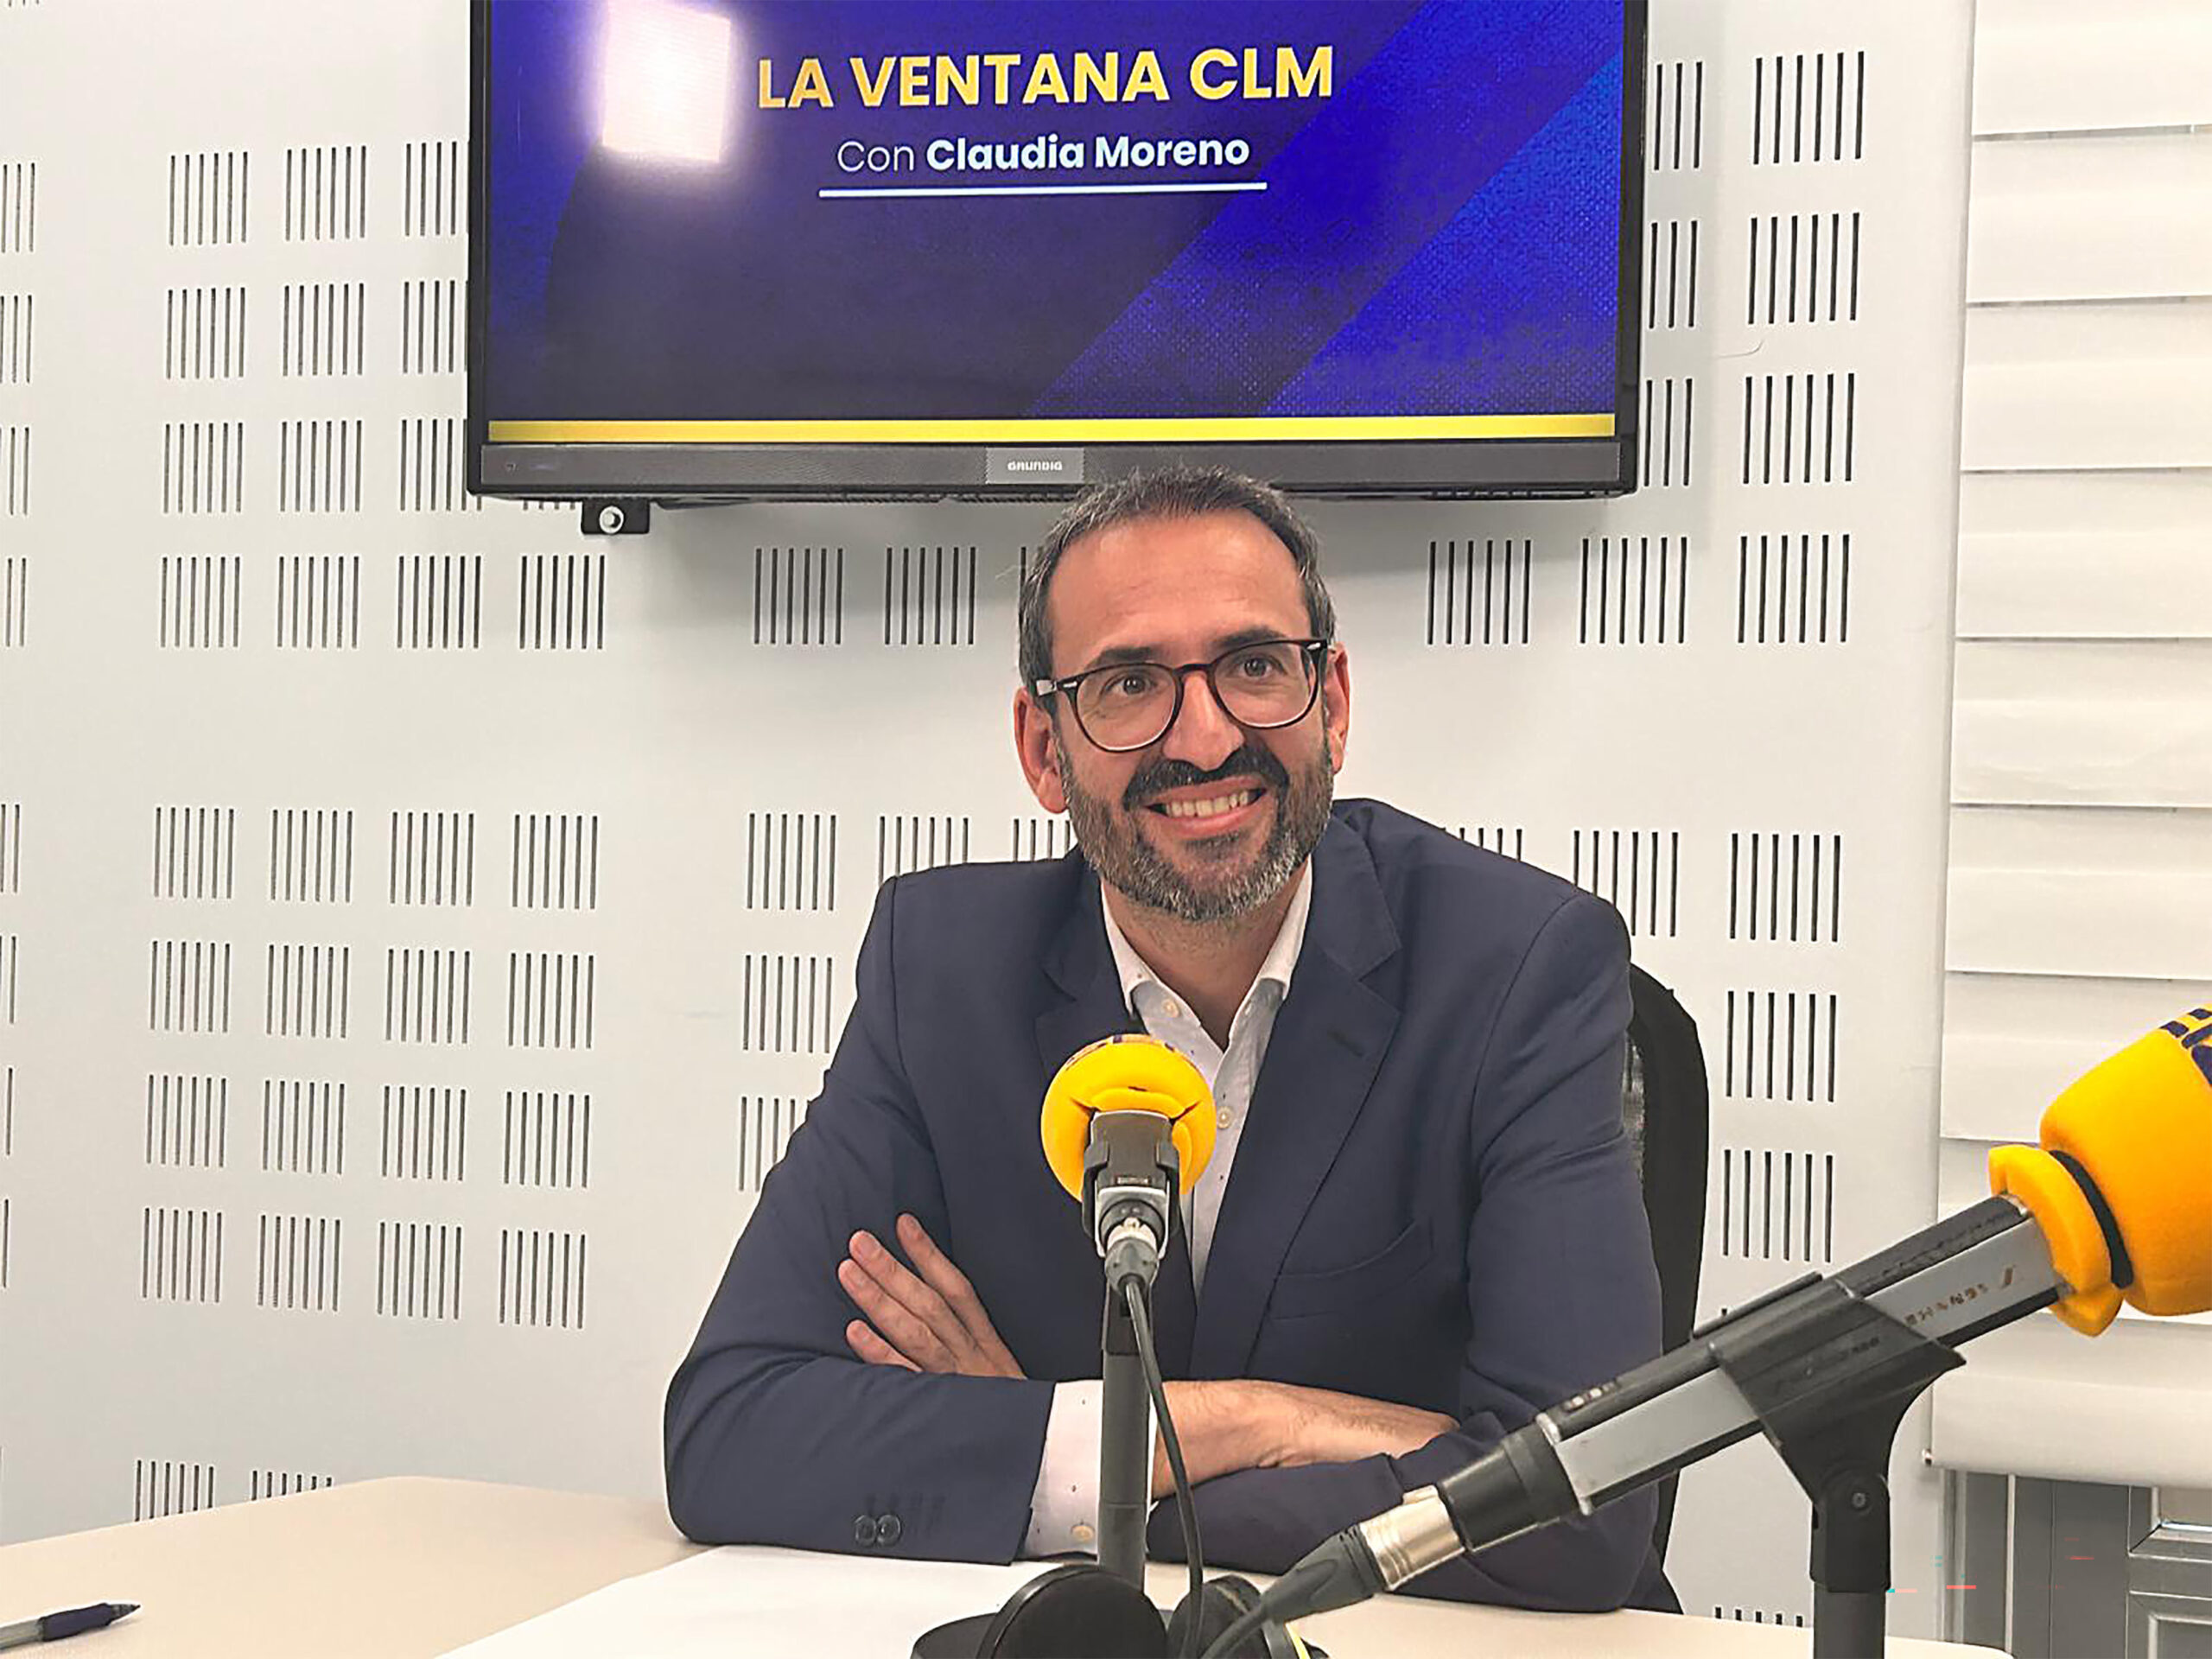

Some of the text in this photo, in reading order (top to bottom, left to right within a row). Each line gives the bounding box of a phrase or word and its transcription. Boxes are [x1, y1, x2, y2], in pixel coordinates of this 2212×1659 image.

[759, 46, 1333, 109] LA VENTANA CLM
[837, 133, 1250, 172] Con Claudia Moreno
[1007, 460, 1064, 472] GRUNDIG
